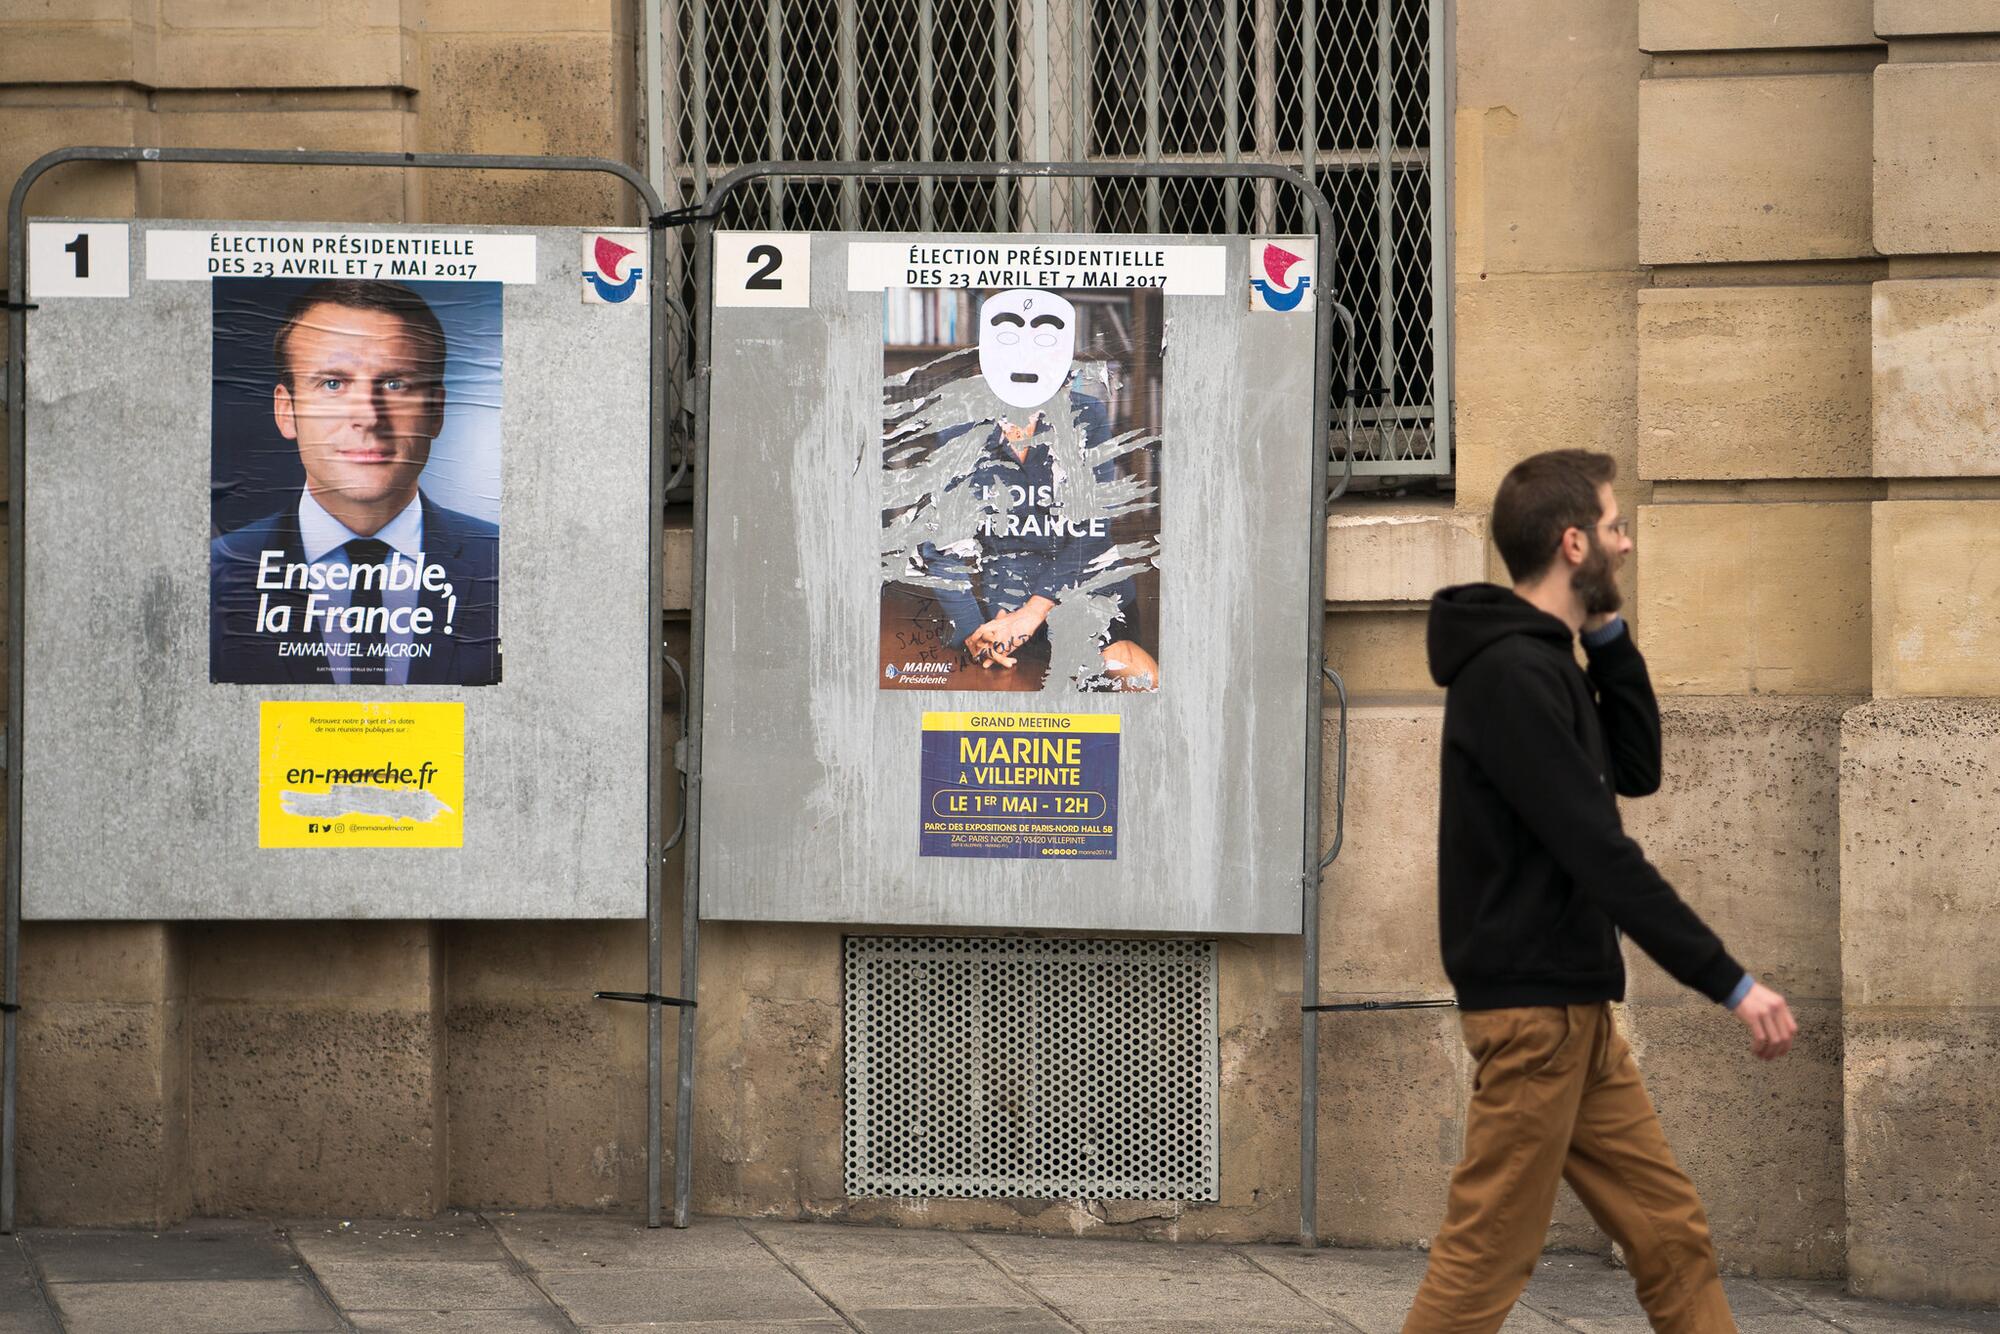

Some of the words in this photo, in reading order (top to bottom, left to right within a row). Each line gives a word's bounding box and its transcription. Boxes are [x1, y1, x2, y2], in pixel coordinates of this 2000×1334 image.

[210, 233, 304, 253] ÉLECTION
[312, 235, 474, 255] PRÉSIDENTIELLE
[65, 234, 89, 278] 1
[909, 245, 999, 264] ÉLECTION
[1007, 246, 1164, 266] PRÉSIDENTIELLE
[208, 258, 245, 273] DES
[253, 262, 274, 278] 23
[282, 259, 338, 274] AVRIL
[346, 259, 368, 274] ET
[374, 263, 383, 278] 7
[391, 260, 426, 276] MAI
[435, 264, 477, 279] 2017
[745, 245, 783, 289] 2
[906, 270, 941, 285] DES
[949, 274, 970, 288] 23
[977, 270, 1032, 286] AVRIL
[1039, 271, 1060, 286] ET
[1066, 275, 1075, 288] 7
[1082, 272, 1117, 287] MAI
[1126, 275, 1167, 288] 2017
[256, 550, 453, 598] Ensemble,
[256, 593, 291, 633] la
[303, 594, 433, 634] France
[444, 595, 457, 635] !
[278, 642, 363, 656] EMMANUEL
[366, 643, 432, 657] MACRON
[902, 662, 952, 673] MARINE
[899, 675, 947, 684] Présidente
[365, 726, 394, 734] publiques
[971, 717, 1015, 727] GRAND
[1019, 717, 1071, 728] MEETING
[960, 737, 1081, 764] MARINE
[286, 761, 438, 790] en-marche.fr
[959, 772, 968, 784] À
[974, 767, 1080, 785] VILLEPINTE
[950, 796, 967, 811] LE
[1002, 797, 1037, 813] MAI
[1055, 797, 1088, 813] 12H
[924, 823, 947, 831] PARC
[948, 823, 963, 831] DES
[965, 824, 1017, 832] EXPOSITIONS
[969, 835, 989, 843] PARIS
[1023, 836, 1046, 844] 93420
